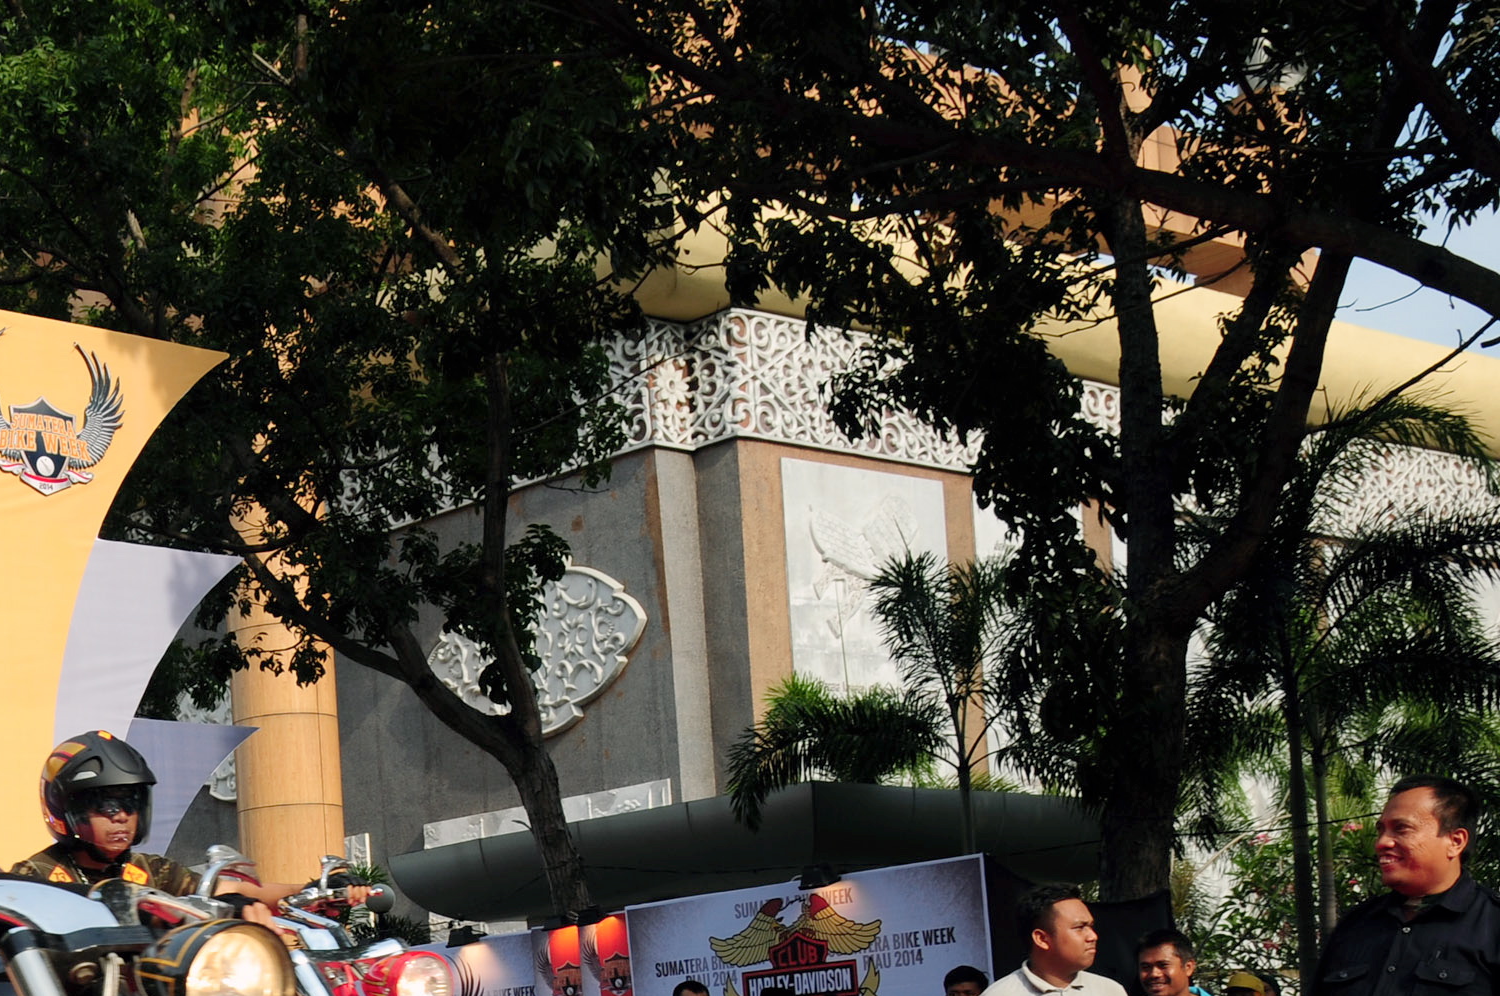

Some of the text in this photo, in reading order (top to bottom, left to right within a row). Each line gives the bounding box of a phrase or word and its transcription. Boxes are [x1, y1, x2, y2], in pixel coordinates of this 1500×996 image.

[10, 413, 76, 438] SUMATERA
[41, 432, 92, 463] WEEK
[893, 930, 920, 950] BIKE
[922, 926, 957, 947] WEEK
[779, 943, 819, 967] CLUB
[863, 948, 924, 971] RAU 2014
[655, 957, 710, 978] SUMATERA
[713, 969, 738, 987] 204
